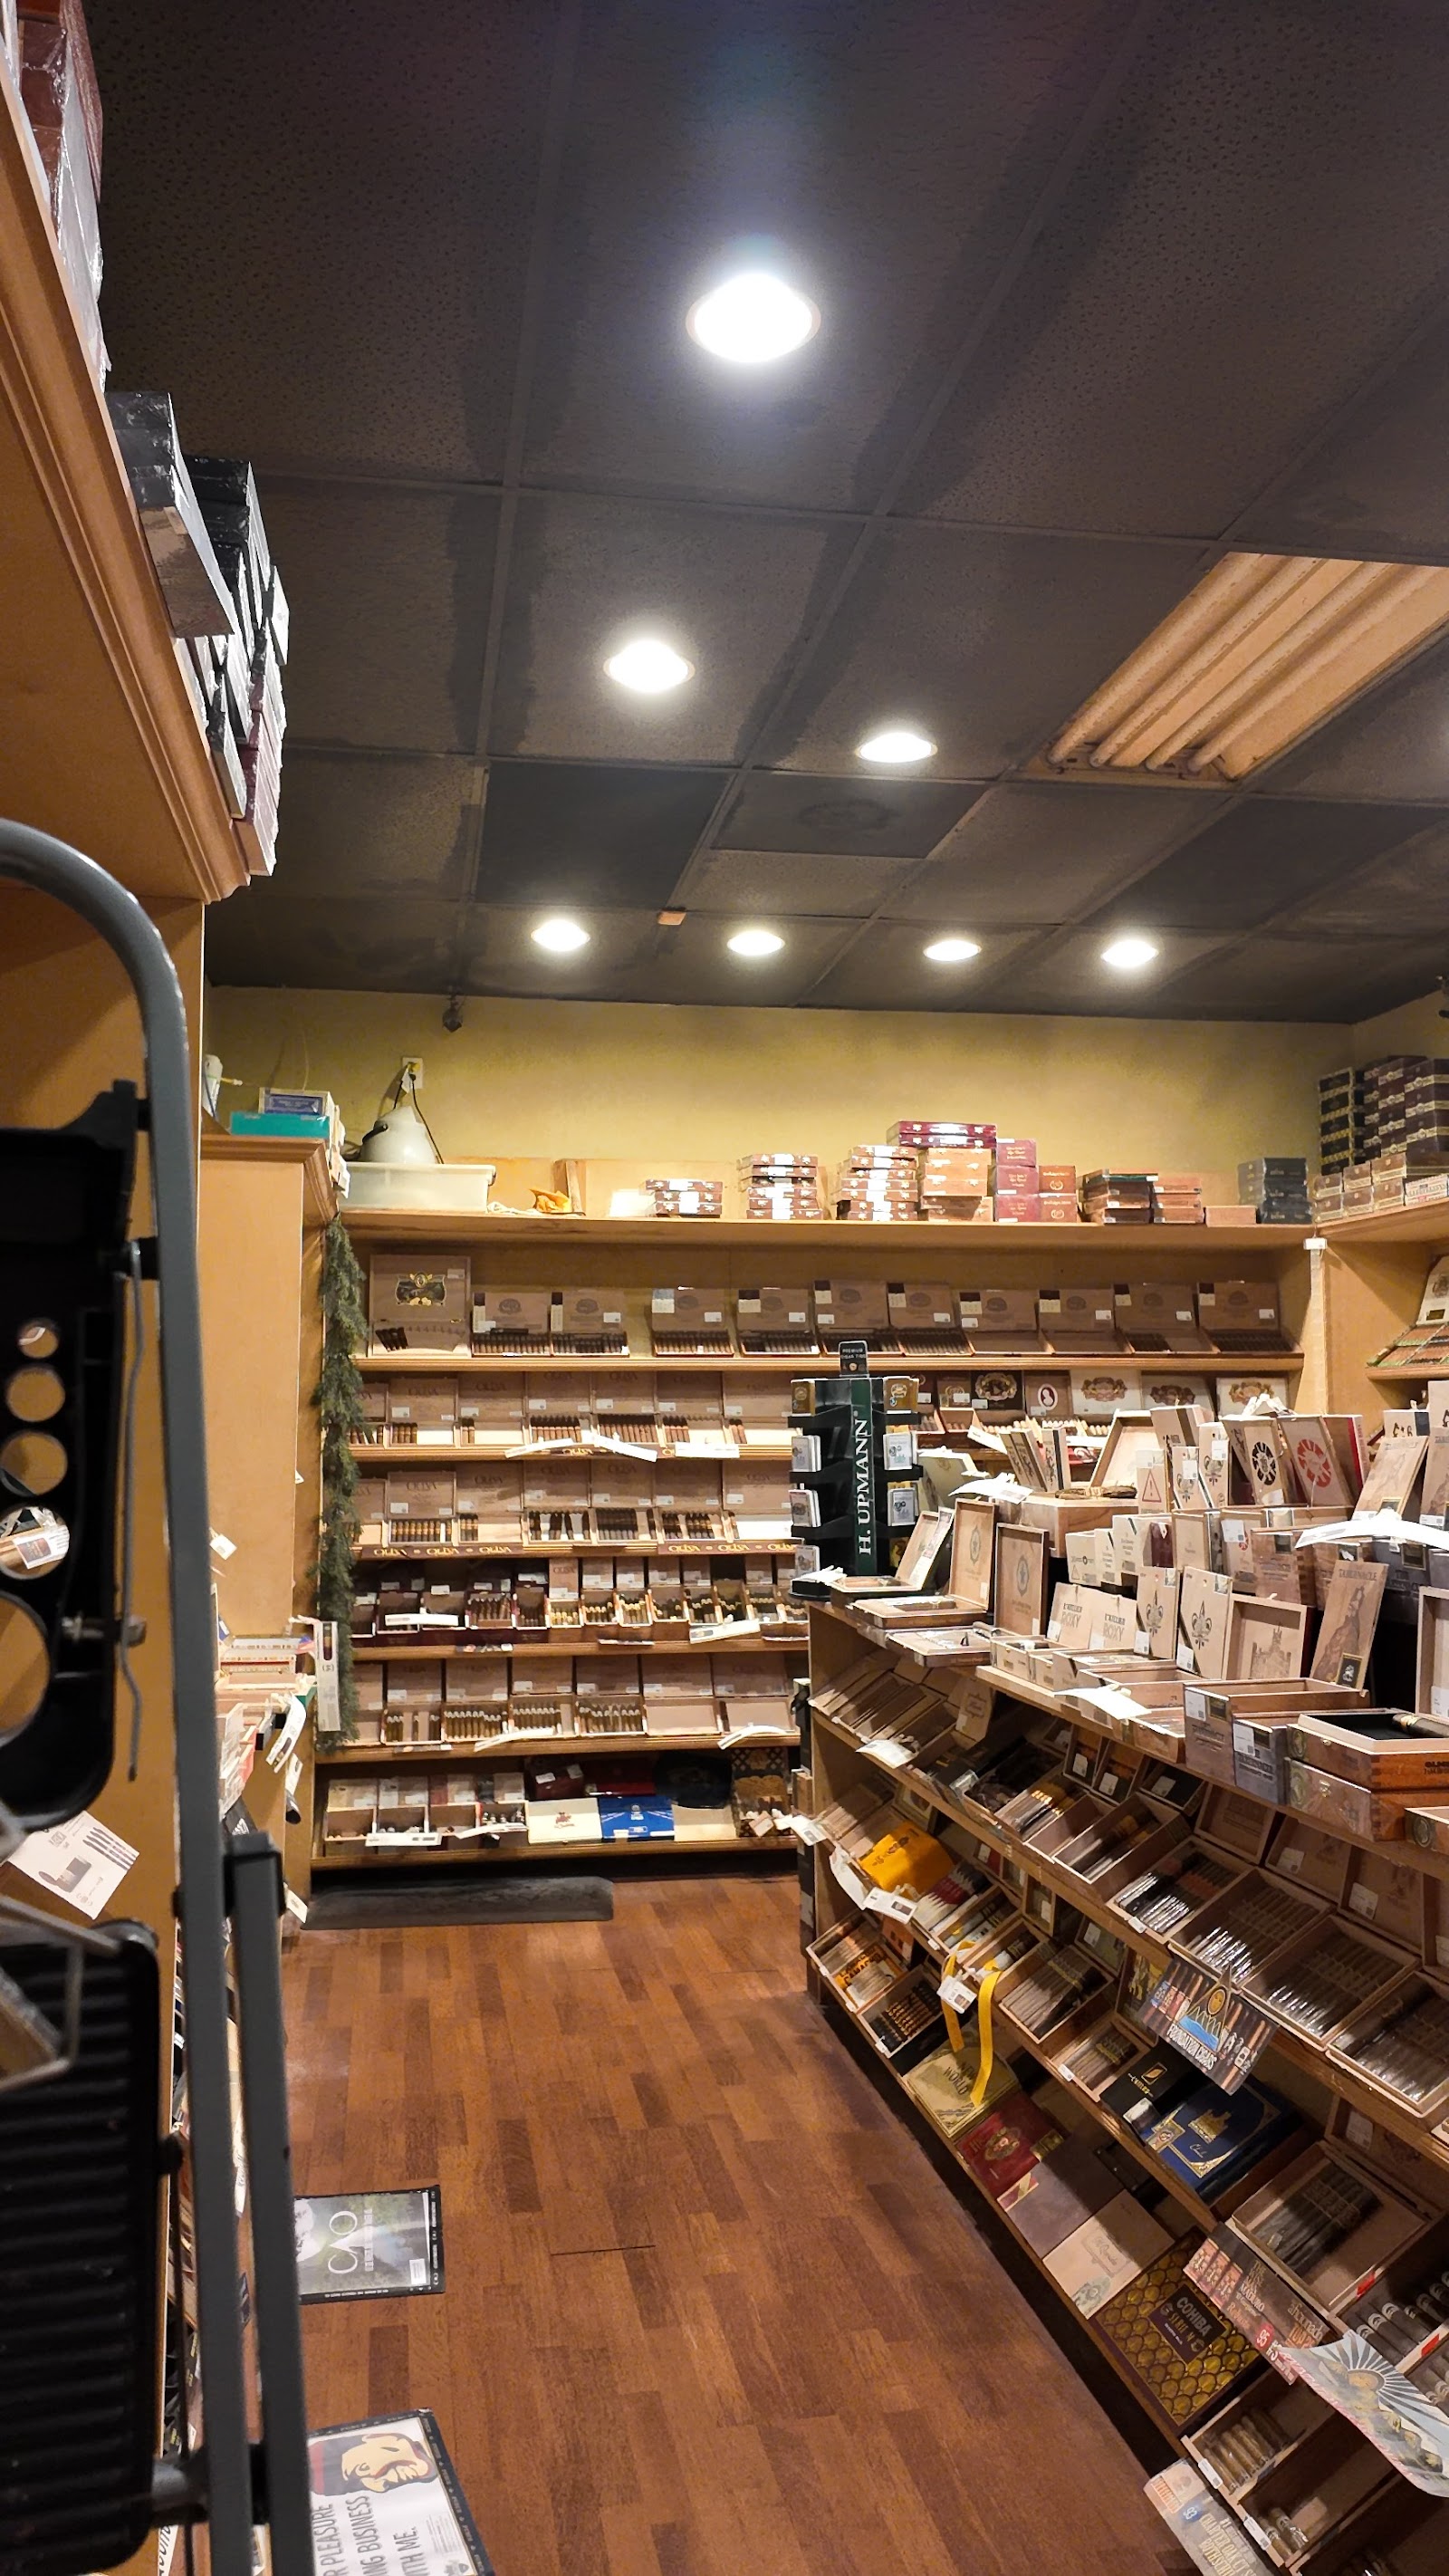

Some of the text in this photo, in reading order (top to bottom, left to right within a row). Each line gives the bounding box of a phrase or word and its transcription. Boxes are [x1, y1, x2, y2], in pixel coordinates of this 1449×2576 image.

[855, 1418, 872, 1555] H. UPMANN
[427, 1547, 460, 1557] OLIVA
[479, 1545, 513, 1555] OLIVA
[668, 1543, 701, 1553] OLIVA
[717, 1543, 751, 1552] OLIVA
[943, 2066, 969, 2095] WORLD
[1177, 2297, 1212, 2337] COHIBA
[1256, 2329, 1271, 2348] 95
[312, 2503, 346, 2567] PLEASURE
[345, 2495, 382, 2553] BUSINESS
[393, 2526, 421, 2552] ME.
